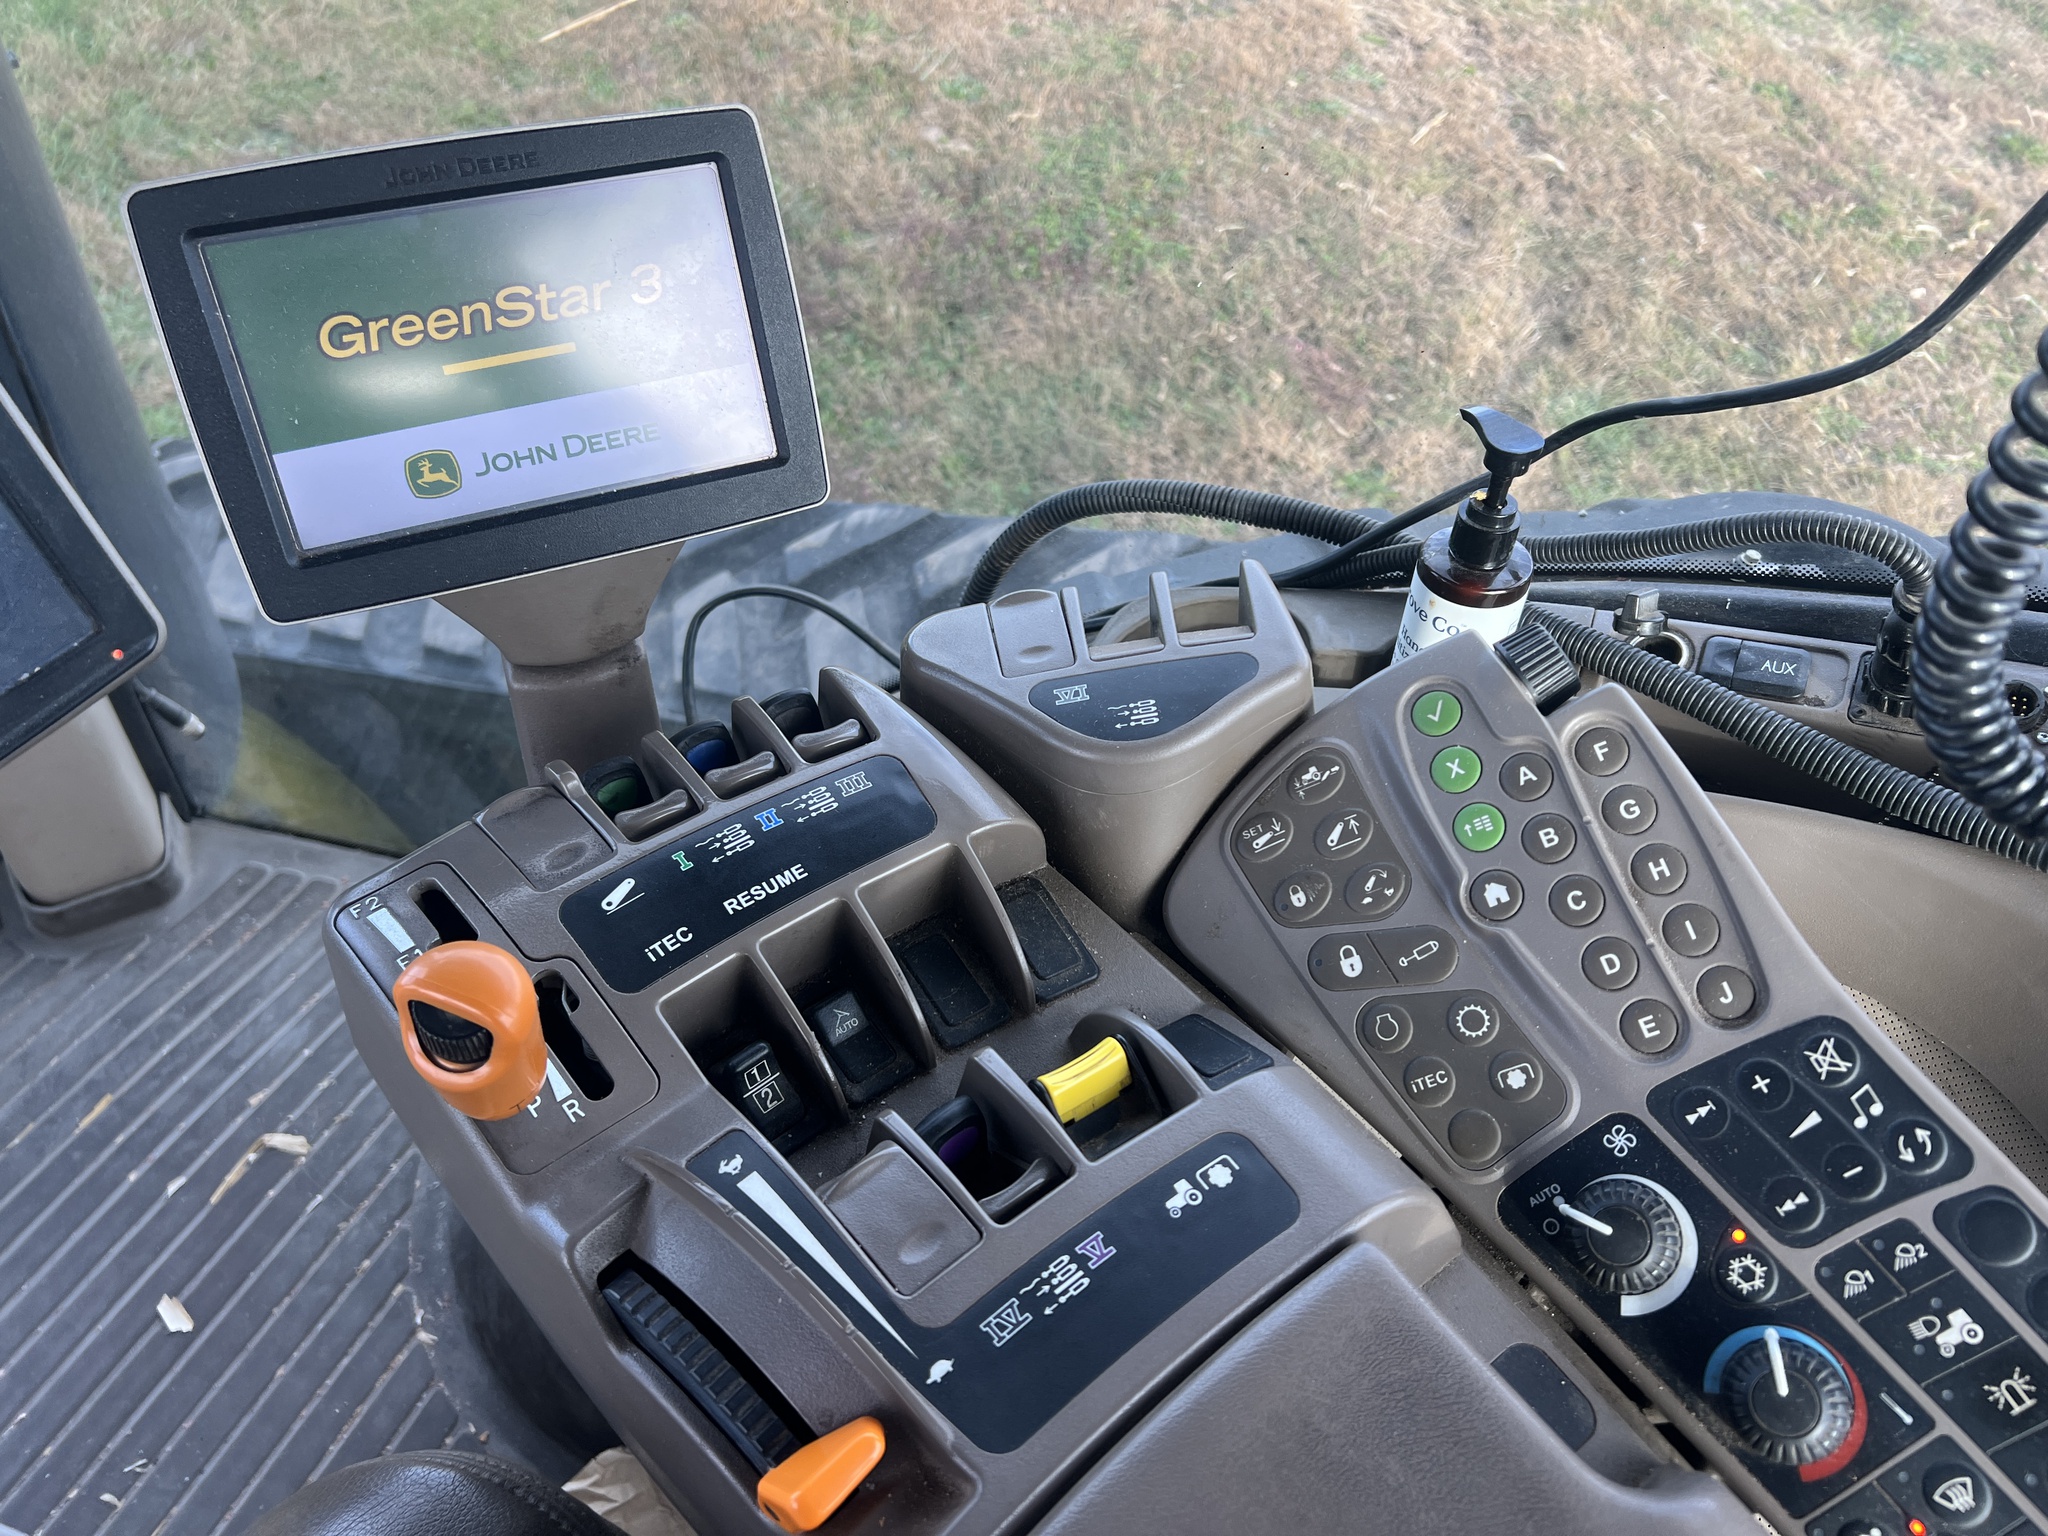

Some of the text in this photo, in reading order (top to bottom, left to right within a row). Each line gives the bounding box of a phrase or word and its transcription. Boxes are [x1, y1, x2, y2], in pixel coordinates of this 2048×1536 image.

[455, 151, 541, 178] DEERE
[318, 263, 662, 359] GreenStar 3
[475, 423, 661, 478] JOHN DEERE
[1408, 594, 1428, 622] ove
[1401, 624, 1424, 653] Han
[1761, 659, 1797, 676] AUX
[1053, 683, 1090, 705] VI
[1593, 740, 1609, 762] F
[834, 771, 873, 797] III
[1519, 765, 1538, 786] A
[1619, 799, 1641, 819] G
[1242, 823, 1263, 840] SET
[1538, 827, 1560, 848] B
[1648, 857, 1671, 881] H
[722, 863, 809, 915] RESUME
[1566, 890, 1587, 911] C
[349, 896, 384, 919] F2
[1684, 919, 1697, 941] I
[644, 926, 693, 962] iTEC
[1599, 953, 1621, 976] D
[1719, 981, 1734, 1004] J
[834, 1017, 859, 1038] AUTO
[1637, 1015, 1661, 1039] E
[1410, 1070, 1449, 1093] iTEC
[761, 1088, 778, 1109] 2
[561, 1099, 586, 1123] R
[1529, 1183, 1561, 1208] AUTO
[1075, 1230, 1117, 1270] V
[979, 1297, 1033, 1347] IV
